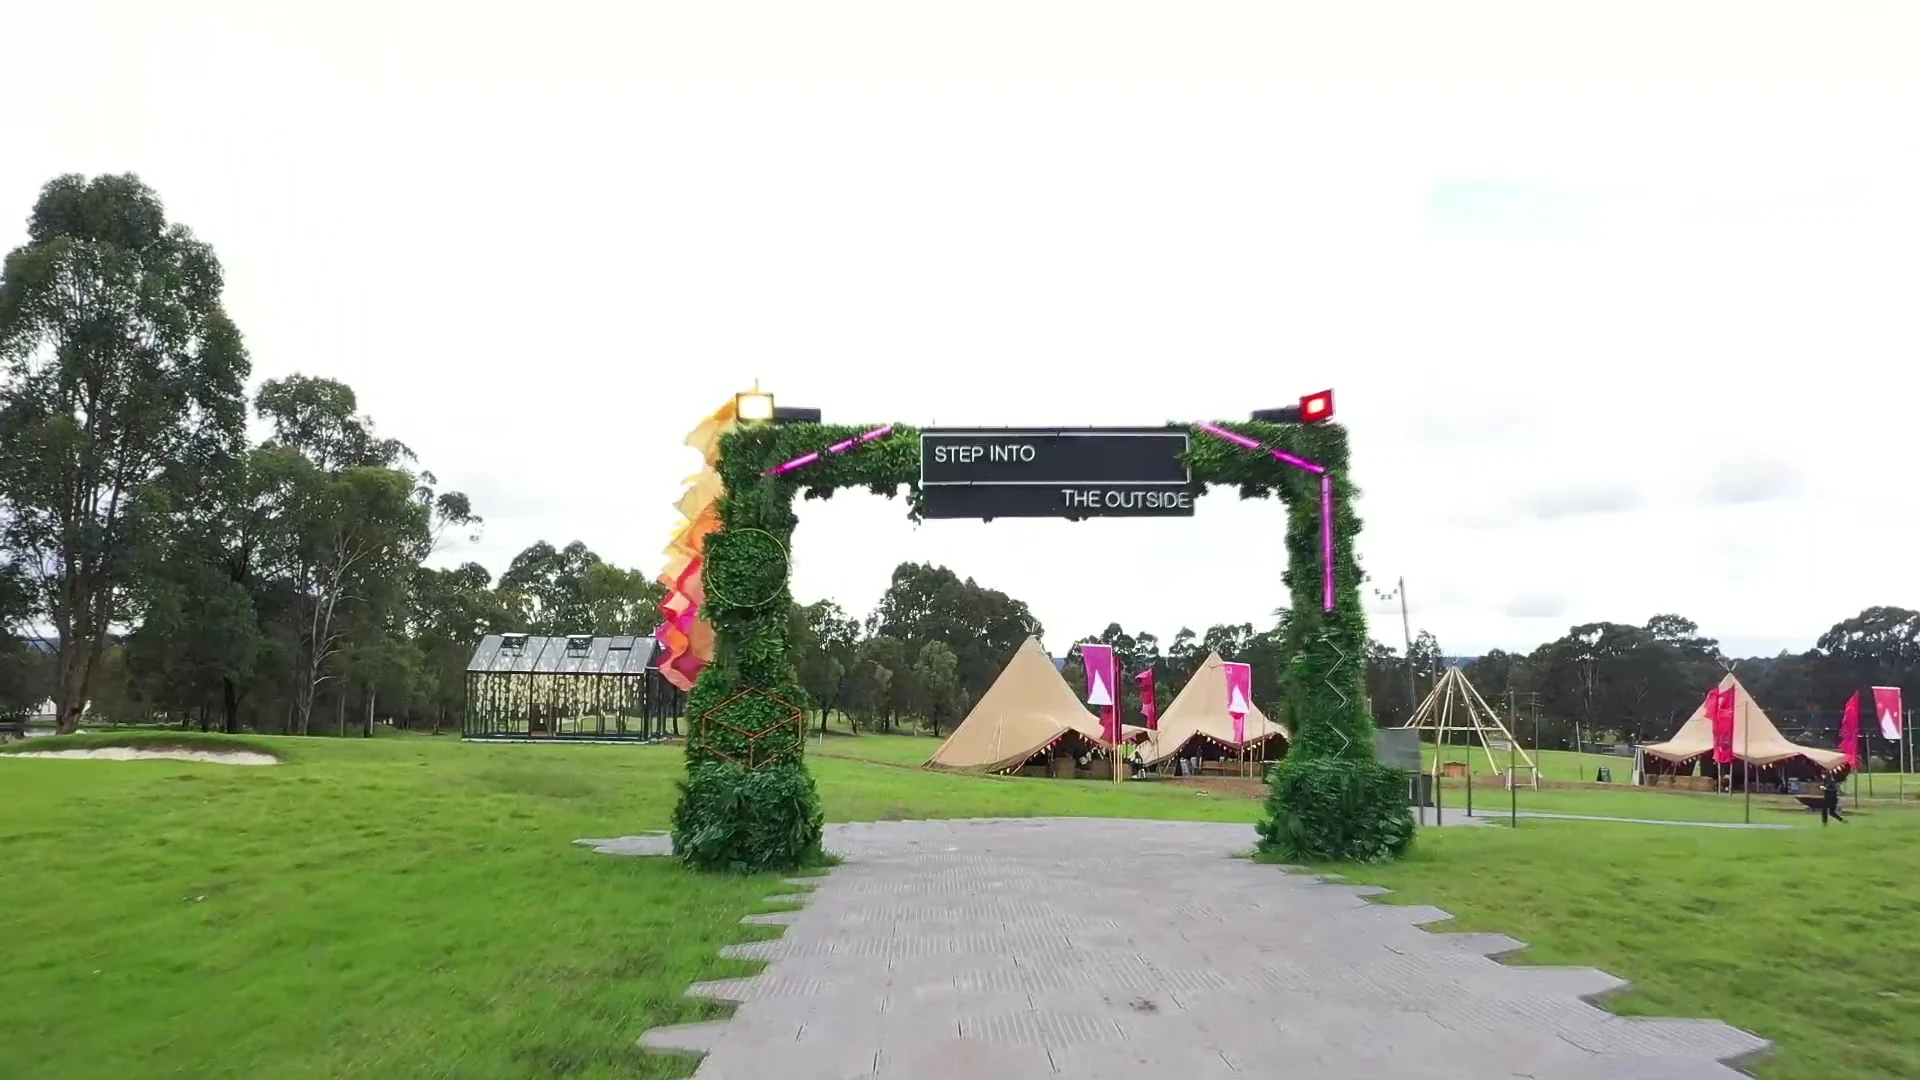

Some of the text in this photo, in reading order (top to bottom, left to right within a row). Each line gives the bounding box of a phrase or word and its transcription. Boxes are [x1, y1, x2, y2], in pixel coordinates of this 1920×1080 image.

[935, 444, 1036, 463] STEP INTO
[1061, 489, 1191, 509] THE OUTSIDE
